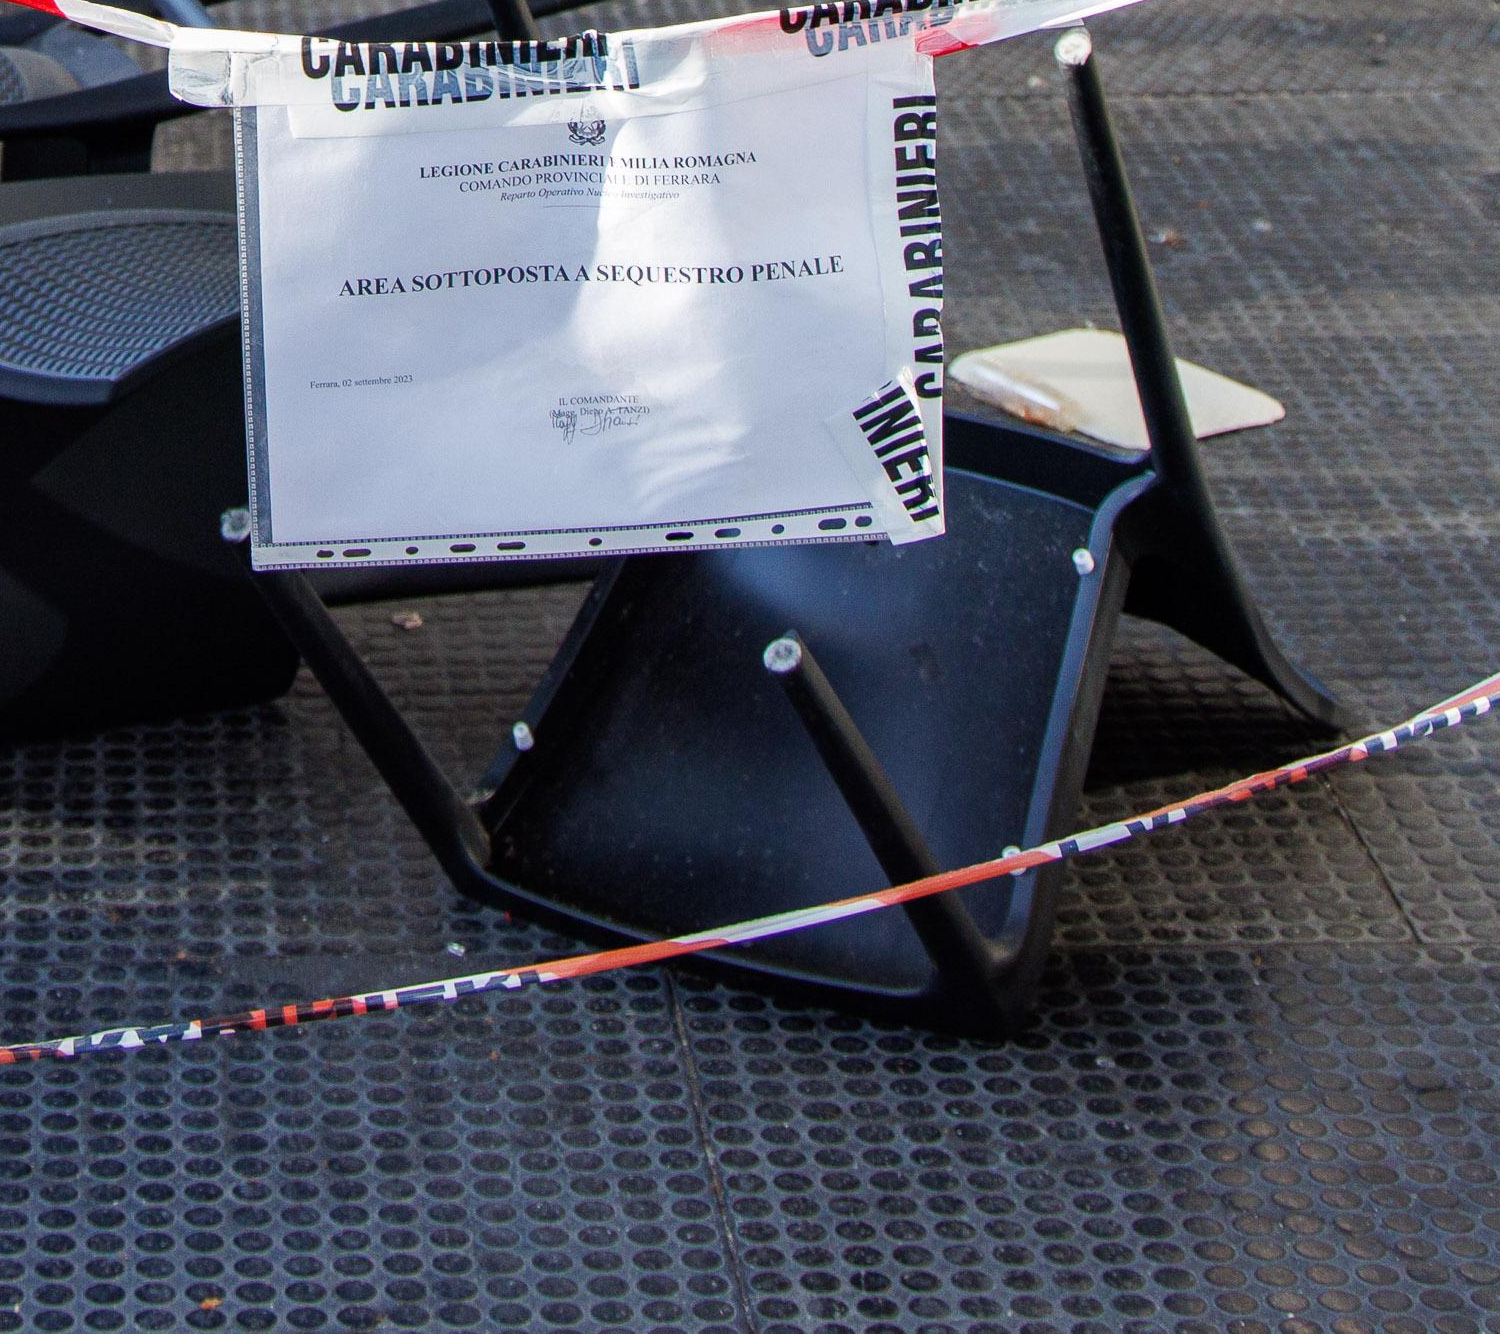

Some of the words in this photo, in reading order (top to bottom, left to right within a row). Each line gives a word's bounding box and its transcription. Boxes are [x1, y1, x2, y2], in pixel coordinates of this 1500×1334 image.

[420, 162, 494, 179] LEGIONE
[498, 154, 605, 173] CARABINIERI
[674, 151, 757, 169] ROMAGNA
[459, 175, 532, 193] COMANDO
[635, 174, 649, 186] DI
[653, 173, 721, 186] FERRARA
[500, 190, 535, 202] Reparto
[538, 187, 584, 200] Operativo
[339, 276, 406, 297] AREA
[411, 264, 569, 292] SOTTOPOSTA
[574, 265, 591, 283] A
[596, 264, 744, 287] SEQUESTRO
[750, 255, 845, 282] PENALE
[342, 378, 352, 387] 02
[354, 376, 392, 386] settembre
[394, 374, 413, 384] 2023
[559, 397, 568, 406] IL
[570, 395, 639, 405] COMANDANTE
